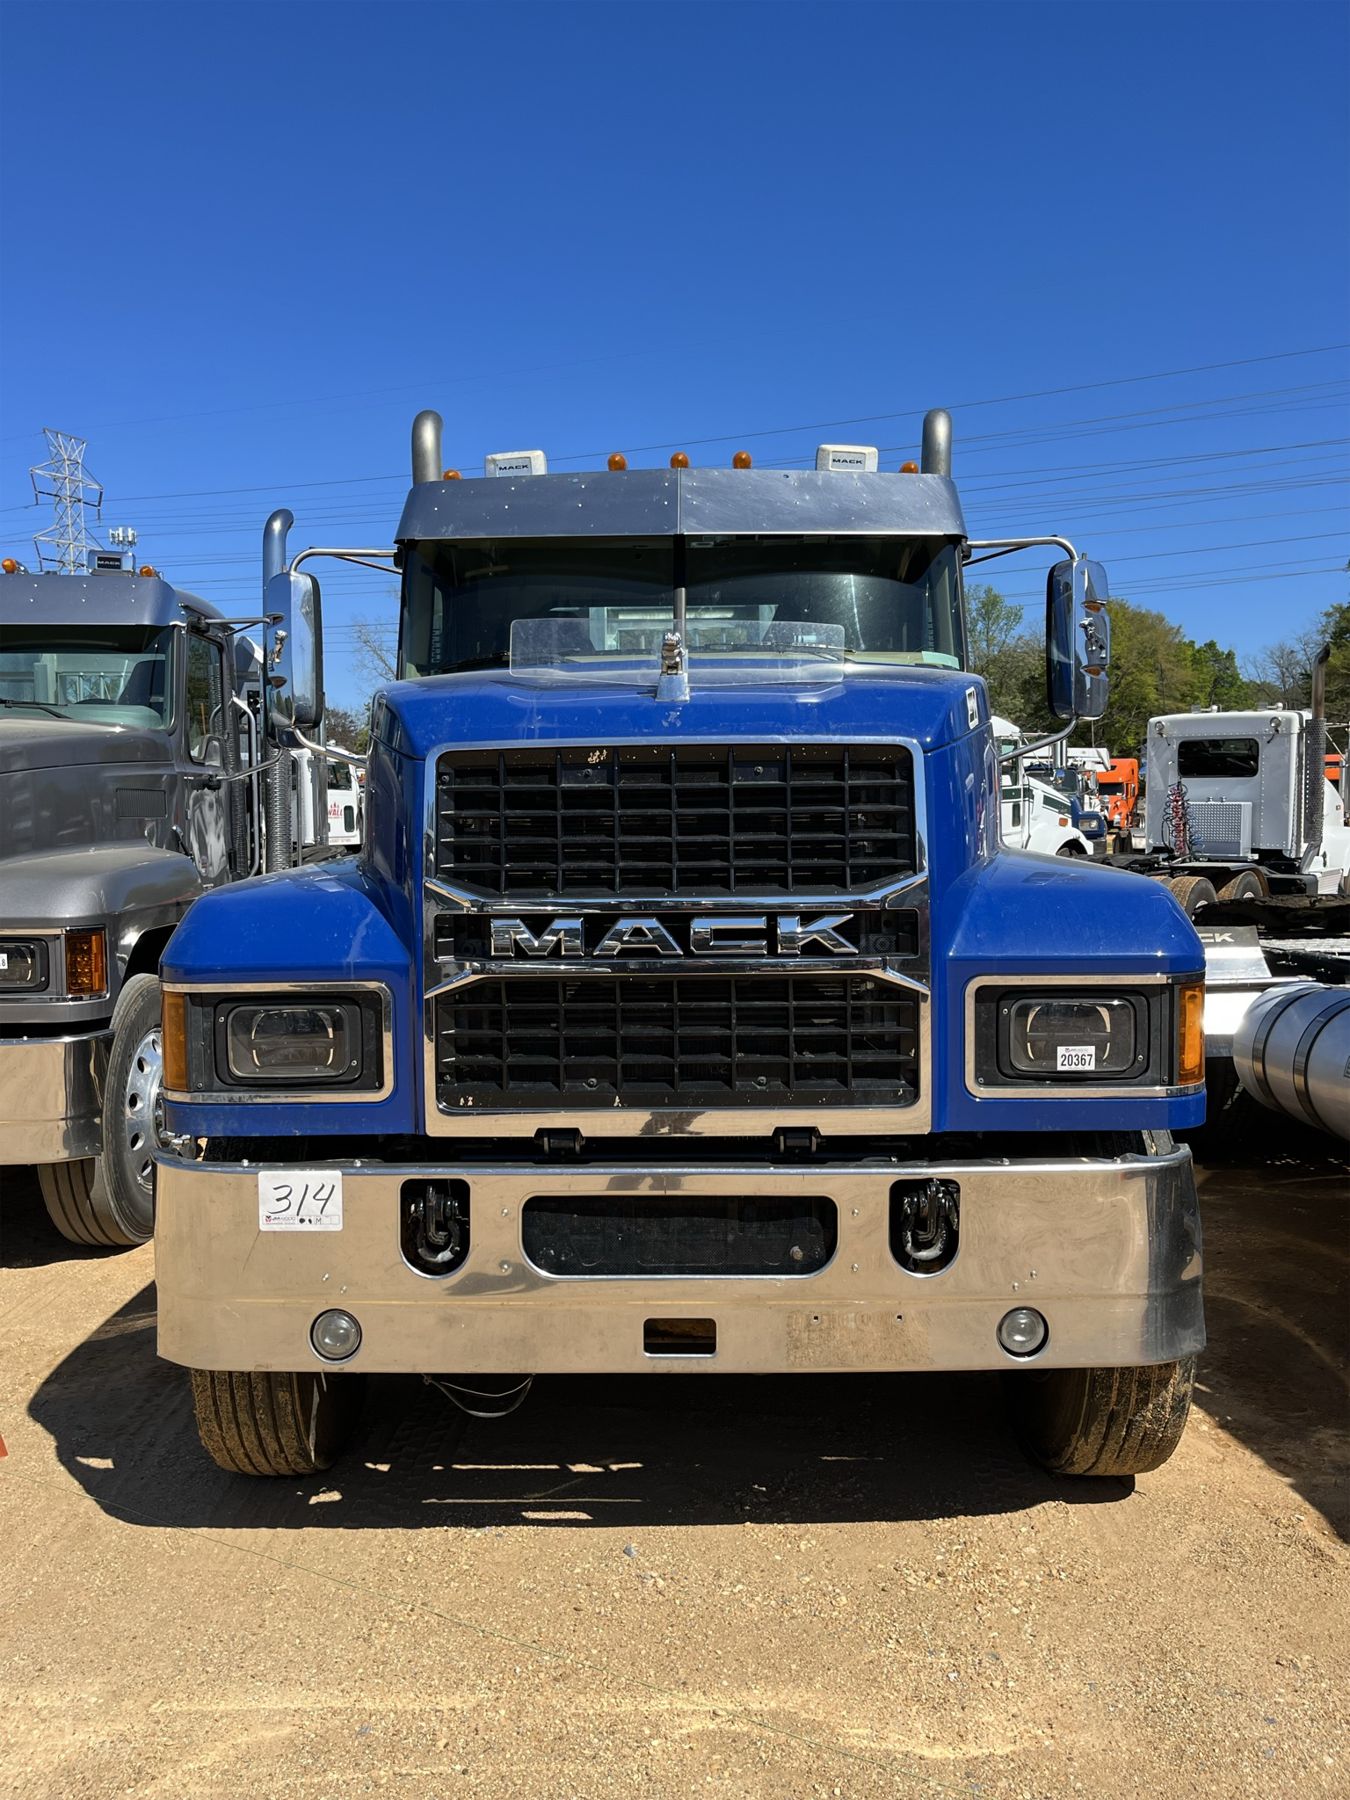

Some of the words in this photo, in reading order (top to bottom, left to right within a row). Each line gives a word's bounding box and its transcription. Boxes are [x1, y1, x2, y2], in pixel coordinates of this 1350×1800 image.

[490, 913, 860, 957] MACK
[1060, 1053, 1093, 1067] 20367
[267, 1183, 336, 1217] 314
